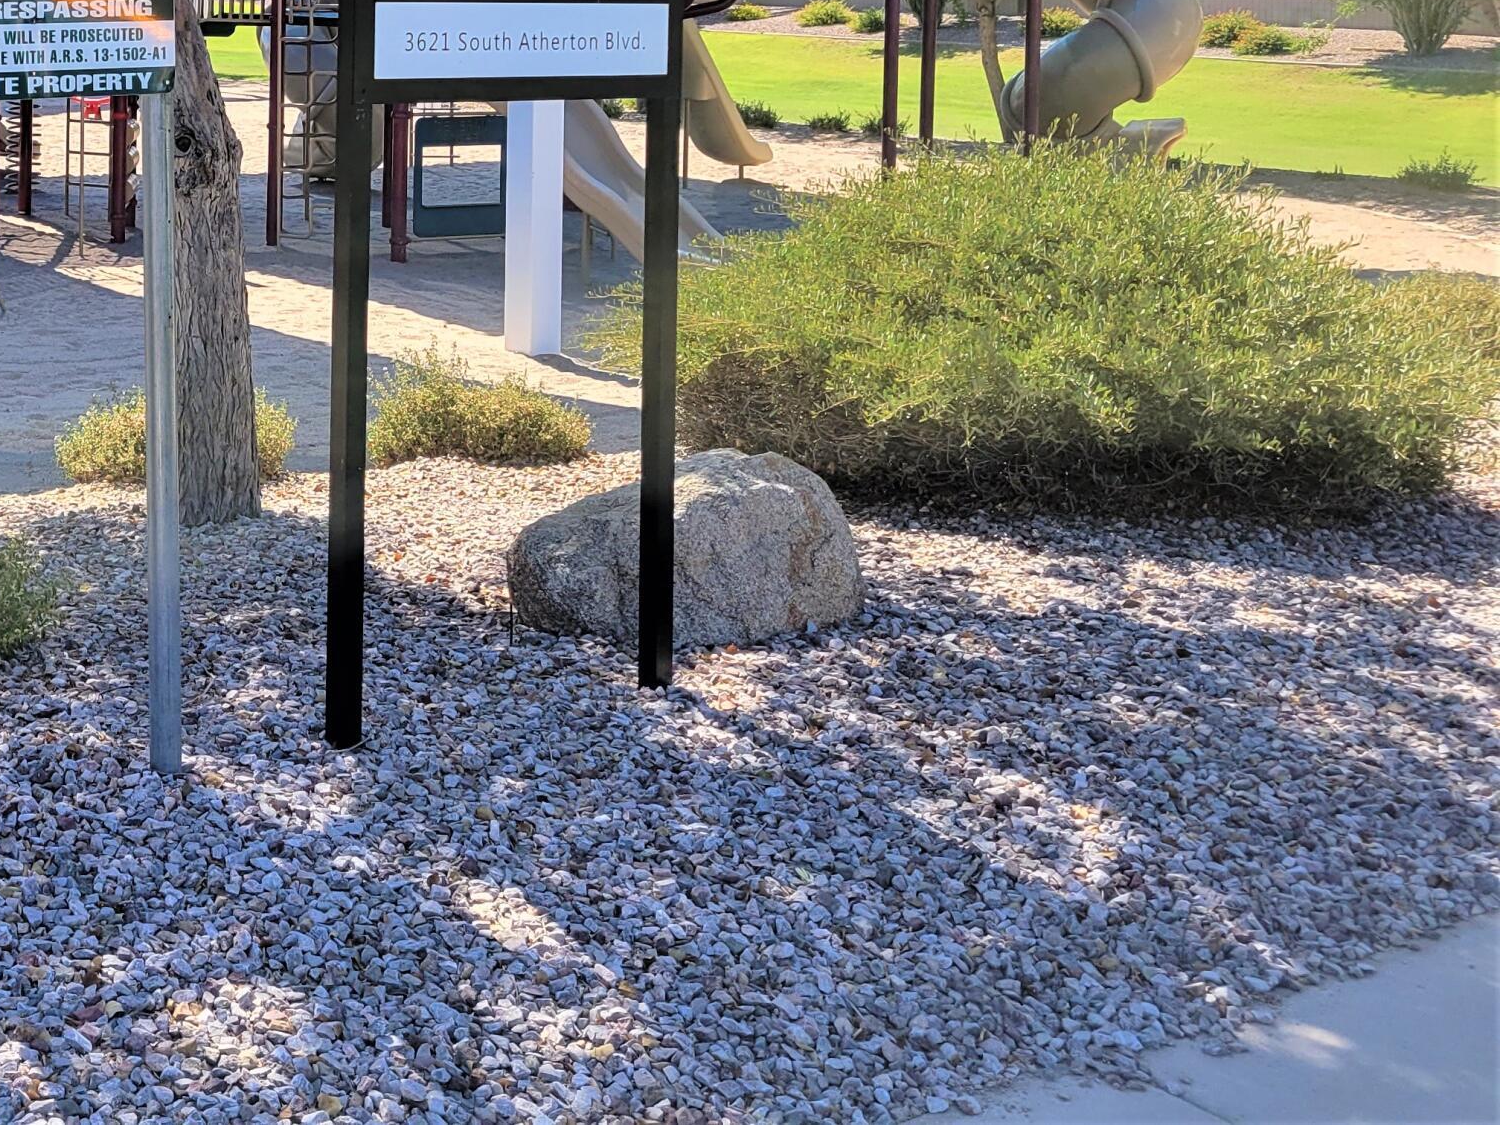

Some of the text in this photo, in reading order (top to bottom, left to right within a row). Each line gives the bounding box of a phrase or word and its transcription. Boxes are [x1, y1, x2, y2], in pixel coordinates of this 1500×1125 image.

[4, 31, 35, 44] WILL
[40, 30, 56, 44] BE
[61, 28, 143, 43] PROSECUTED
[405, 32, 646, 51] 3621 South Atherton Blvd.
[13, 51, 45, 65] WITH
[49, 50, 88, 63] A.R.S.
[93, 47, 167, 62] 13-1502-A1
[27, 73, 153, 94] PROPERTY
